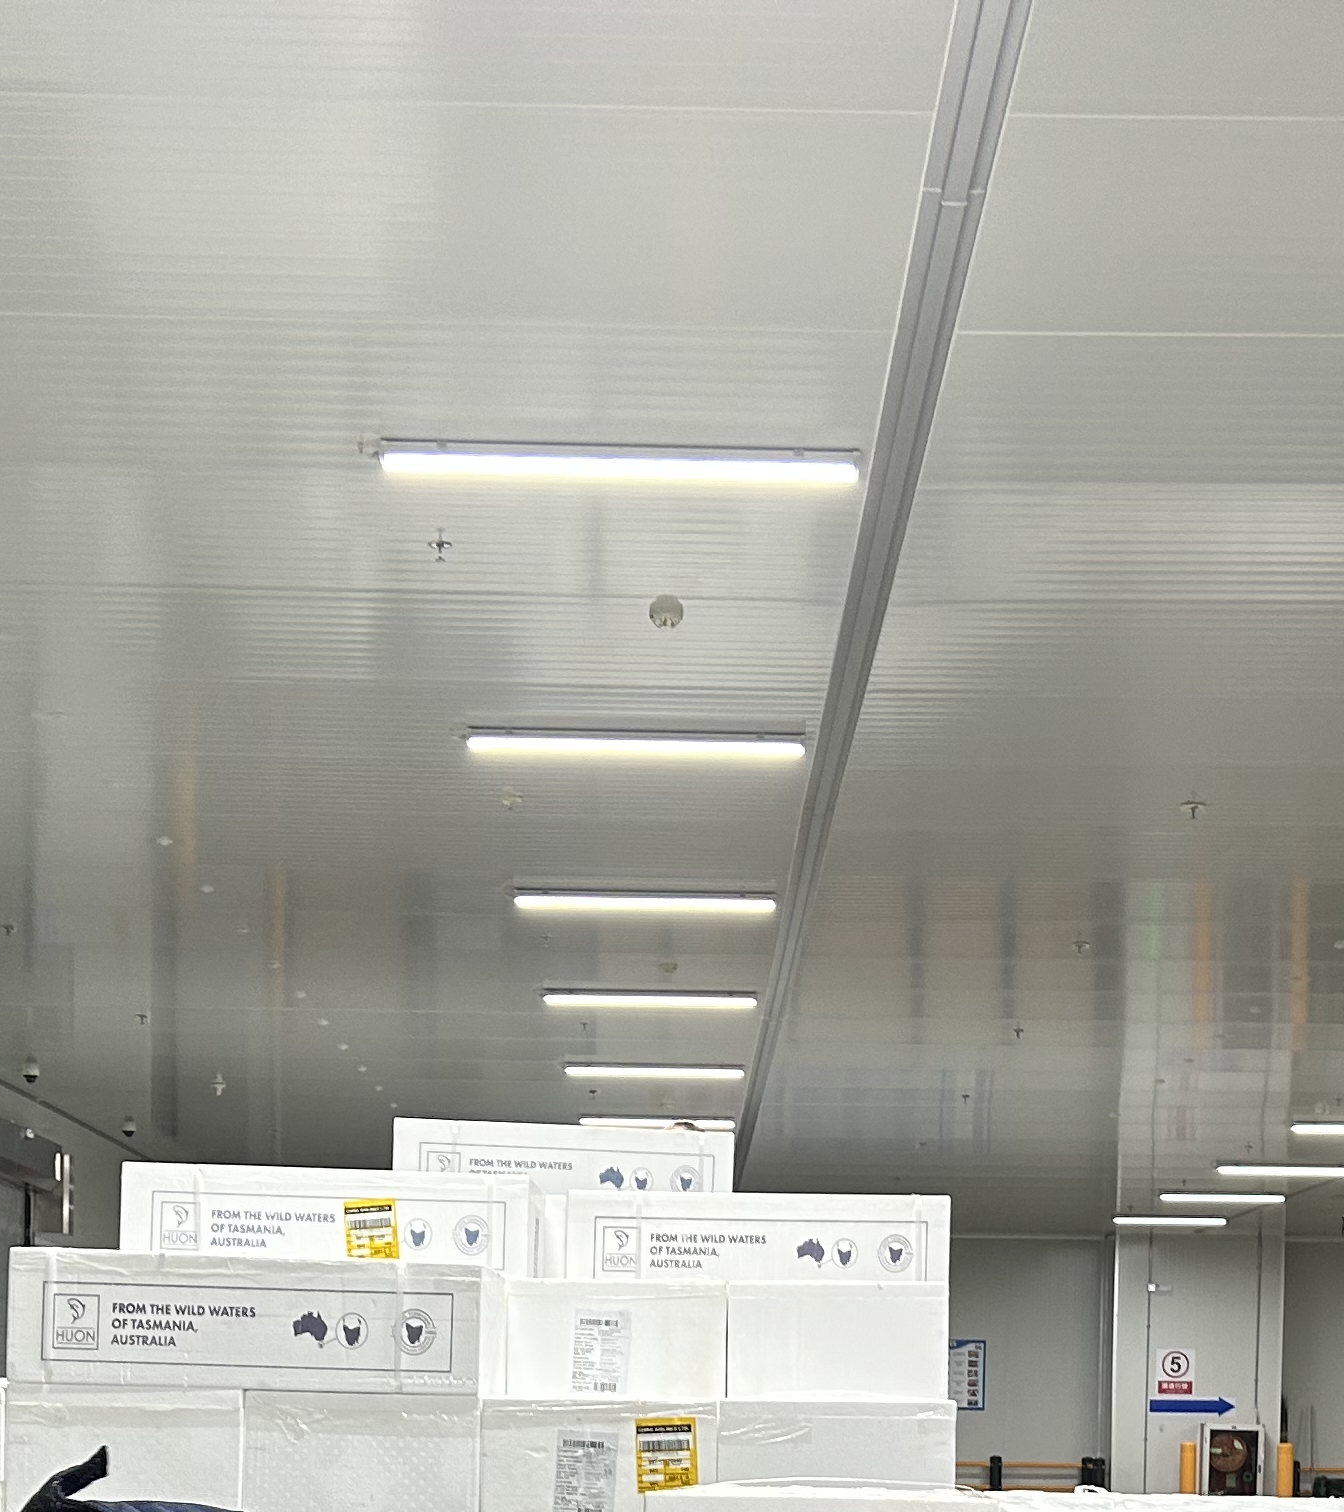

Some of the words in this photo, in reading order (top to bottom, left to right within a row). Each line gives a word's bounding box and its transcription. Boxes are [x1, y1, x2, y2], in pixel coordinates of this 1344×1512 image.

[469, 1158, 494, 1167] FROM
[496, 1159, 512, 1168] THE
[514, 1160, 536, 1169] WILD
[539, 1161, 573, 1170] WATERS
[211, 1209, 241, 1220] FROM
[243, 1210, 262, 1220] THE
[264, 1211, 292, 1221] WILD
[294, 1212, 336, 1223] WATERS
[211, 1223, 225, 1233] OF
[163, 1232, 197, 1243] HUON
[210, 1237, 267, 1248] AUSTRALIA
[650, 1233, 678, 1243] FROM
[680, 1233, 697, 1243] THE
[700, 1234, 726, 1243] WILD
[728, 1234, 767, 1244] WATERS
[650, 1246, 663, 1255] OF
[605, 1255, 637, 1265] HUON
[649, 1259, 702, 1269] AUSTRALIA
[111, 1302, 146, 1314] FROM
[149, 1303, 171, 1315] THE
[174, 1304, 205, 1316] WILD
[208, 1305, 257, 1318] WATERS
[111, 1318, 128, 1330] OF
[56, 1329, 95, 1342] HUON
[110, 1334, 176, 1347] AUSTRALIA
[1170, 1356, 1182, 1373] 5
